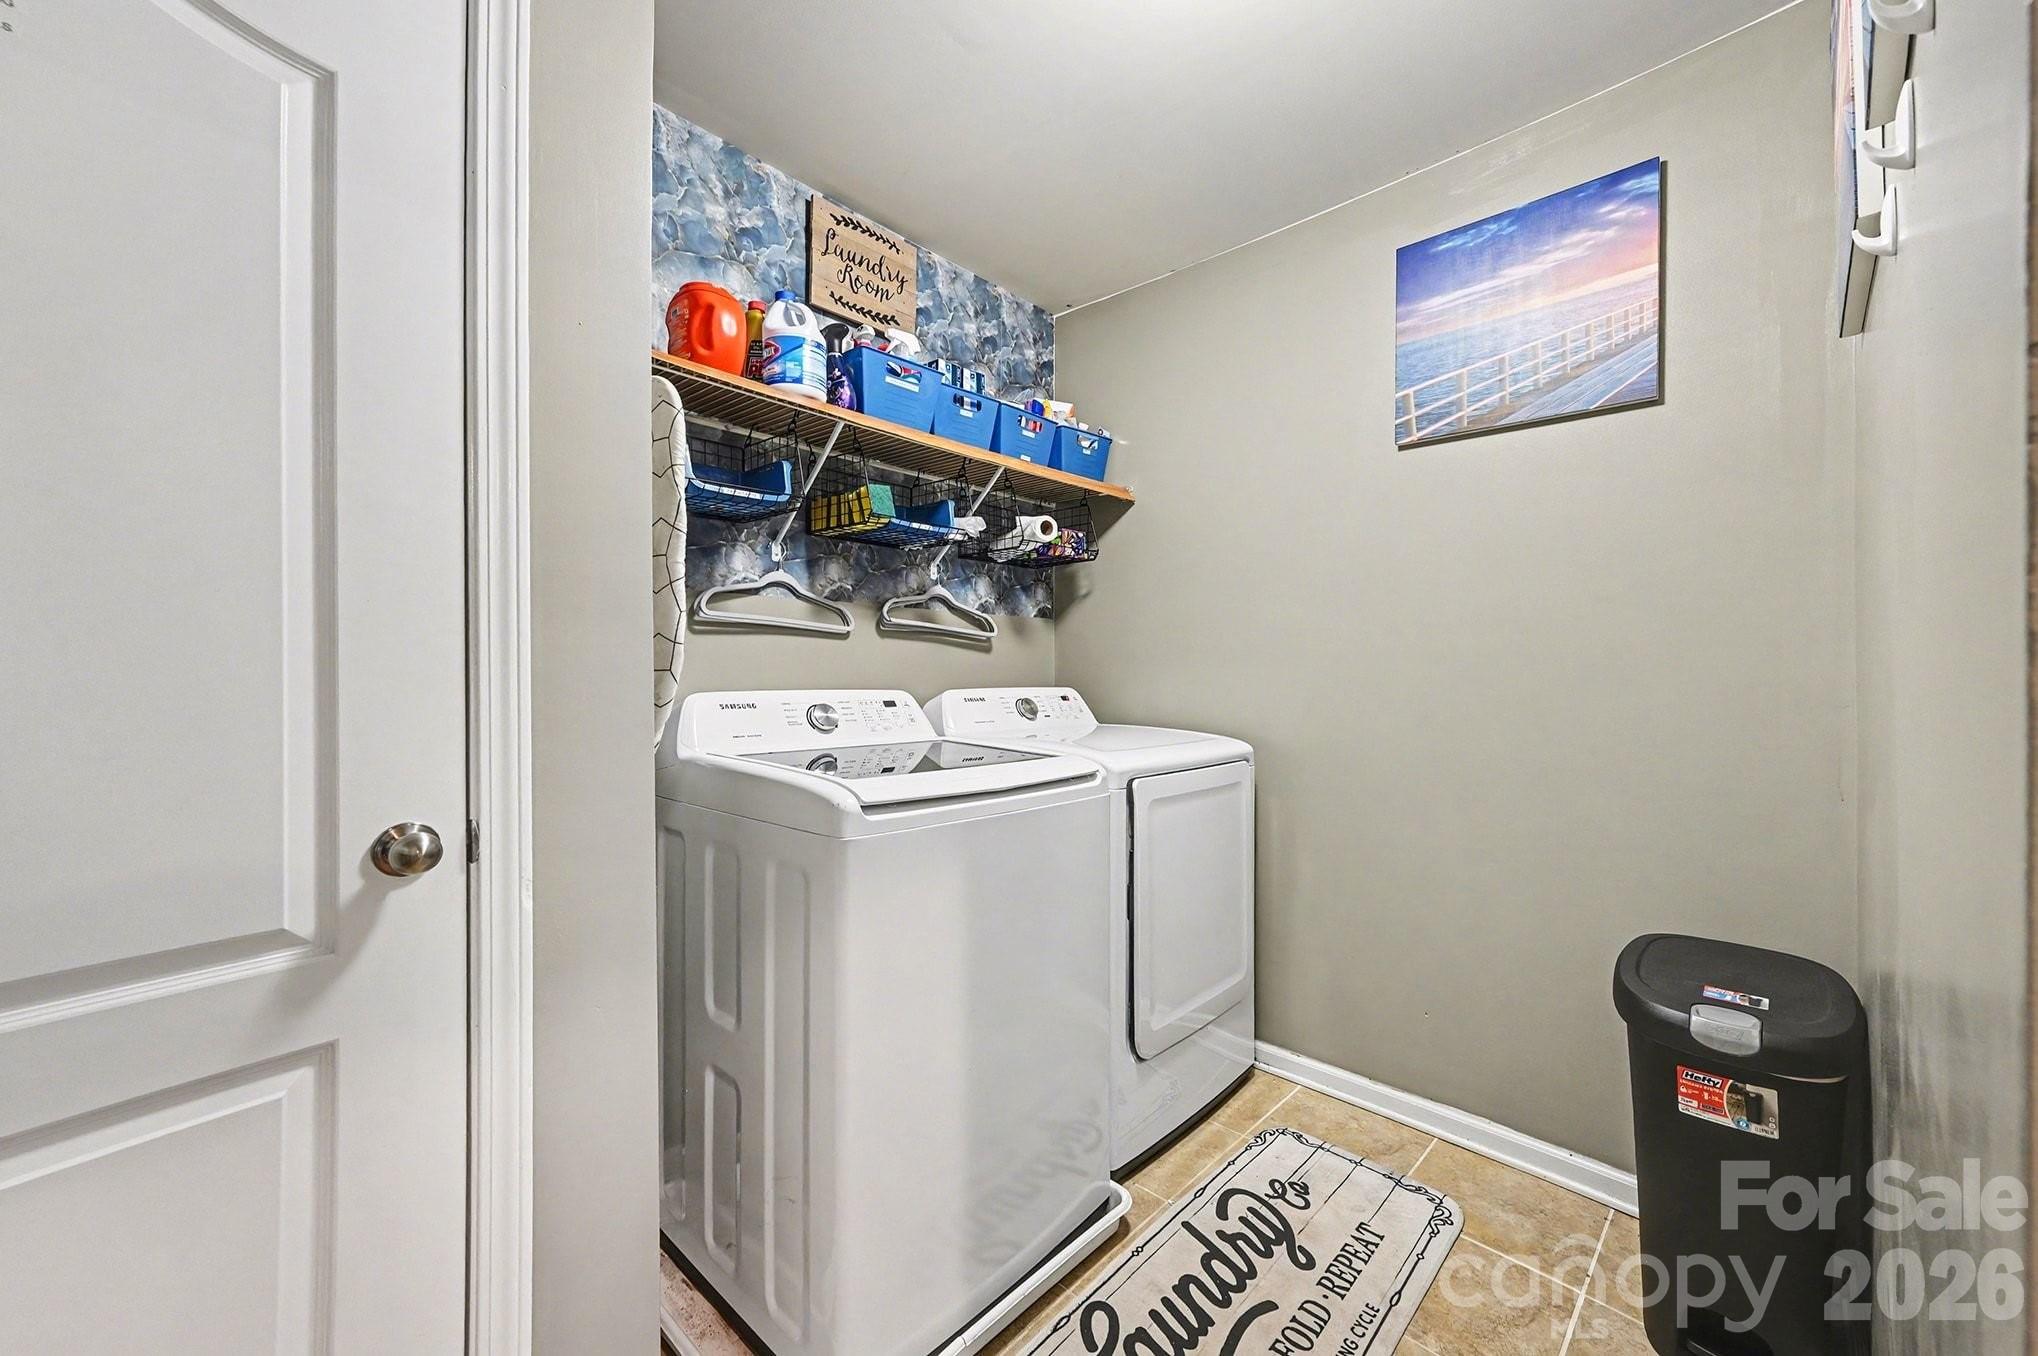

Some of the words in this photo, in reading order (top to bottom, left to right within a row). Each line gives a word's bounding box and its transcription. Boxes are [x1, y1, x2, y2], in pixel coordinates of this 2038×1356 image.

[821, 227, 908, 294] Laundry
[836, 264, 895, 302] Room
[719, 702, 757, 710] SAMSUNG
[1684, 1071, 1721, 1088] Hefty
[1268, 1300, 1331, 1356] FOLD
[1316, 1222, 1385, 1301] REPEAT
[1350, 1302, 1381, 1339] CYCLE
